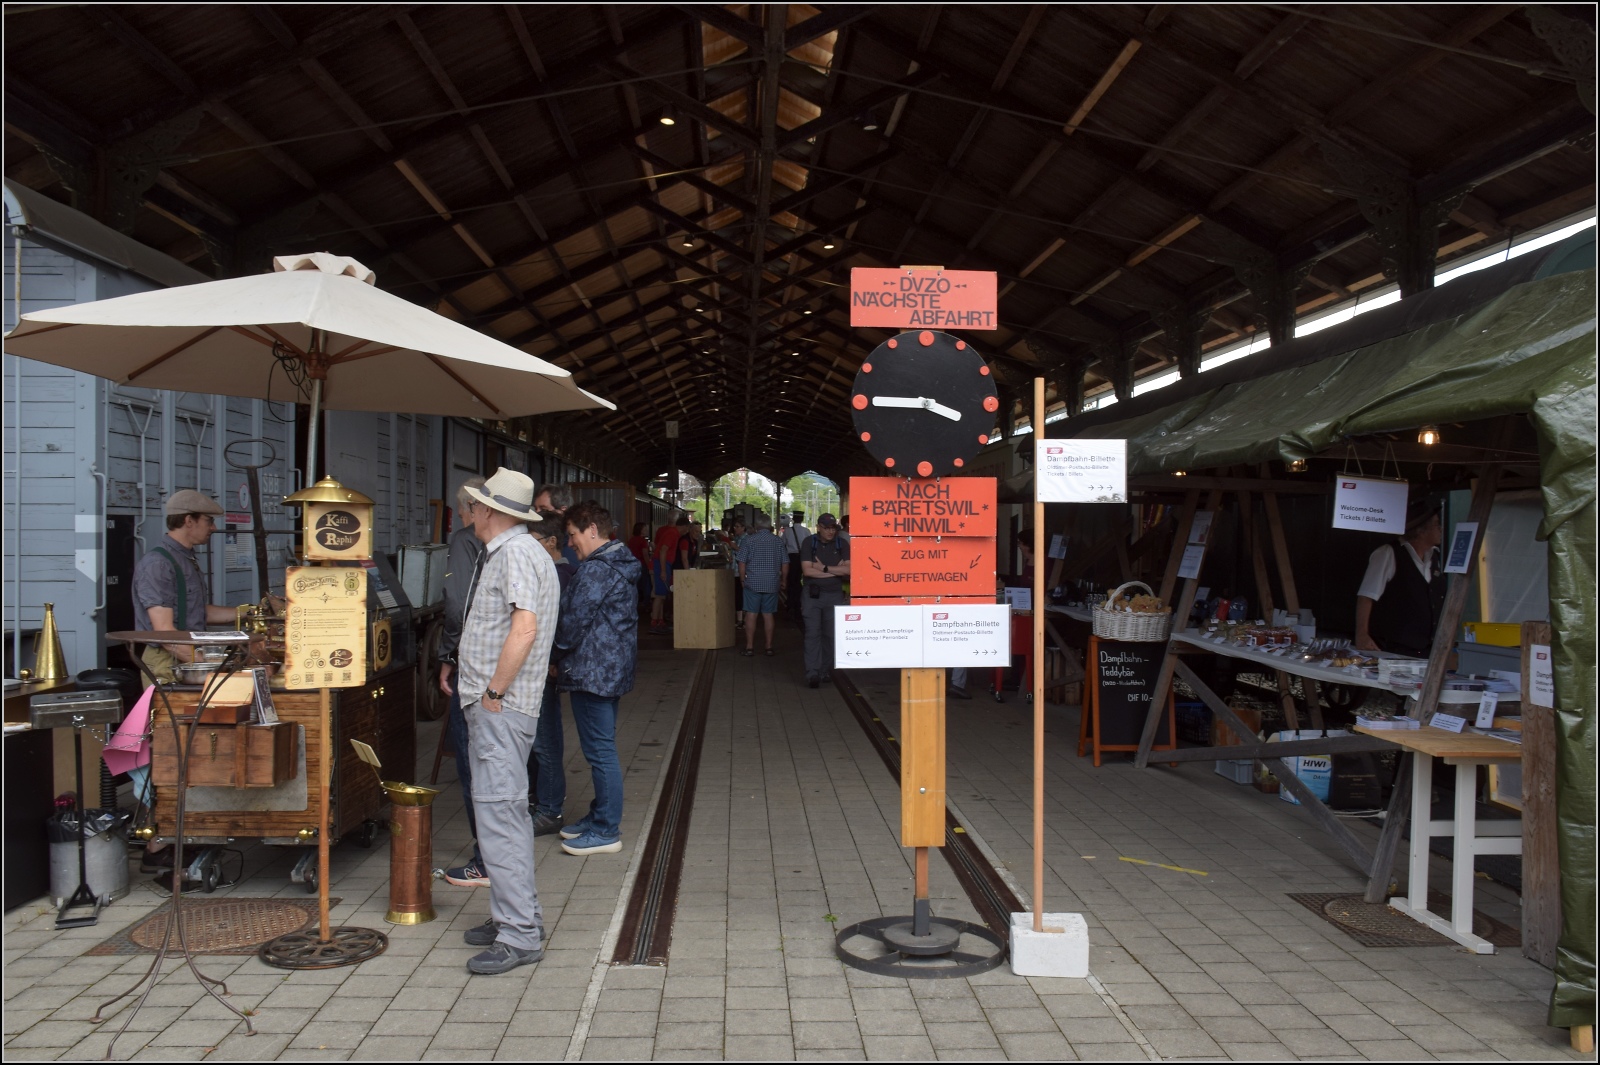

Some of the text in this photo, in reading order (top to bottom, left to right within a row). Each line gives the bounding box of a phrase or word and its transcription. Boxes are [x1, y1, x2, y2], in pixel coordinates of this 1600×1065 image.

[900, 276, 951, 294] DVZO
[853, 291, 941, 309] NÄCHSTE
[909, 309, 995, 326] ABFAHRT
[896, 484, 950, 499] NACH
[872, 500, 980, 516] BÄRETSWIL
[1340, 504, 1384, 514] Welcome-Desk
[325, 513, 349, 527] Kaffi
[893, 517, 957, 533] HINWIL
[1339, 513, 1361, 521] Tickets
[1365, 515, 1386, 523] Billette
[324, 532, 352, 546] Raphi
[901, 549, 949, 560] ZUG MIT
[884, 572, 968, 583] BUFFETWAGEN
[932, 620, 1000, 629] Dampfbahn-Billette
[1100, 665, 1135, 679] Teddybär
[1127, 693, 1140, 702] CHF
[1303, 759, 1327, 768] HIWI
